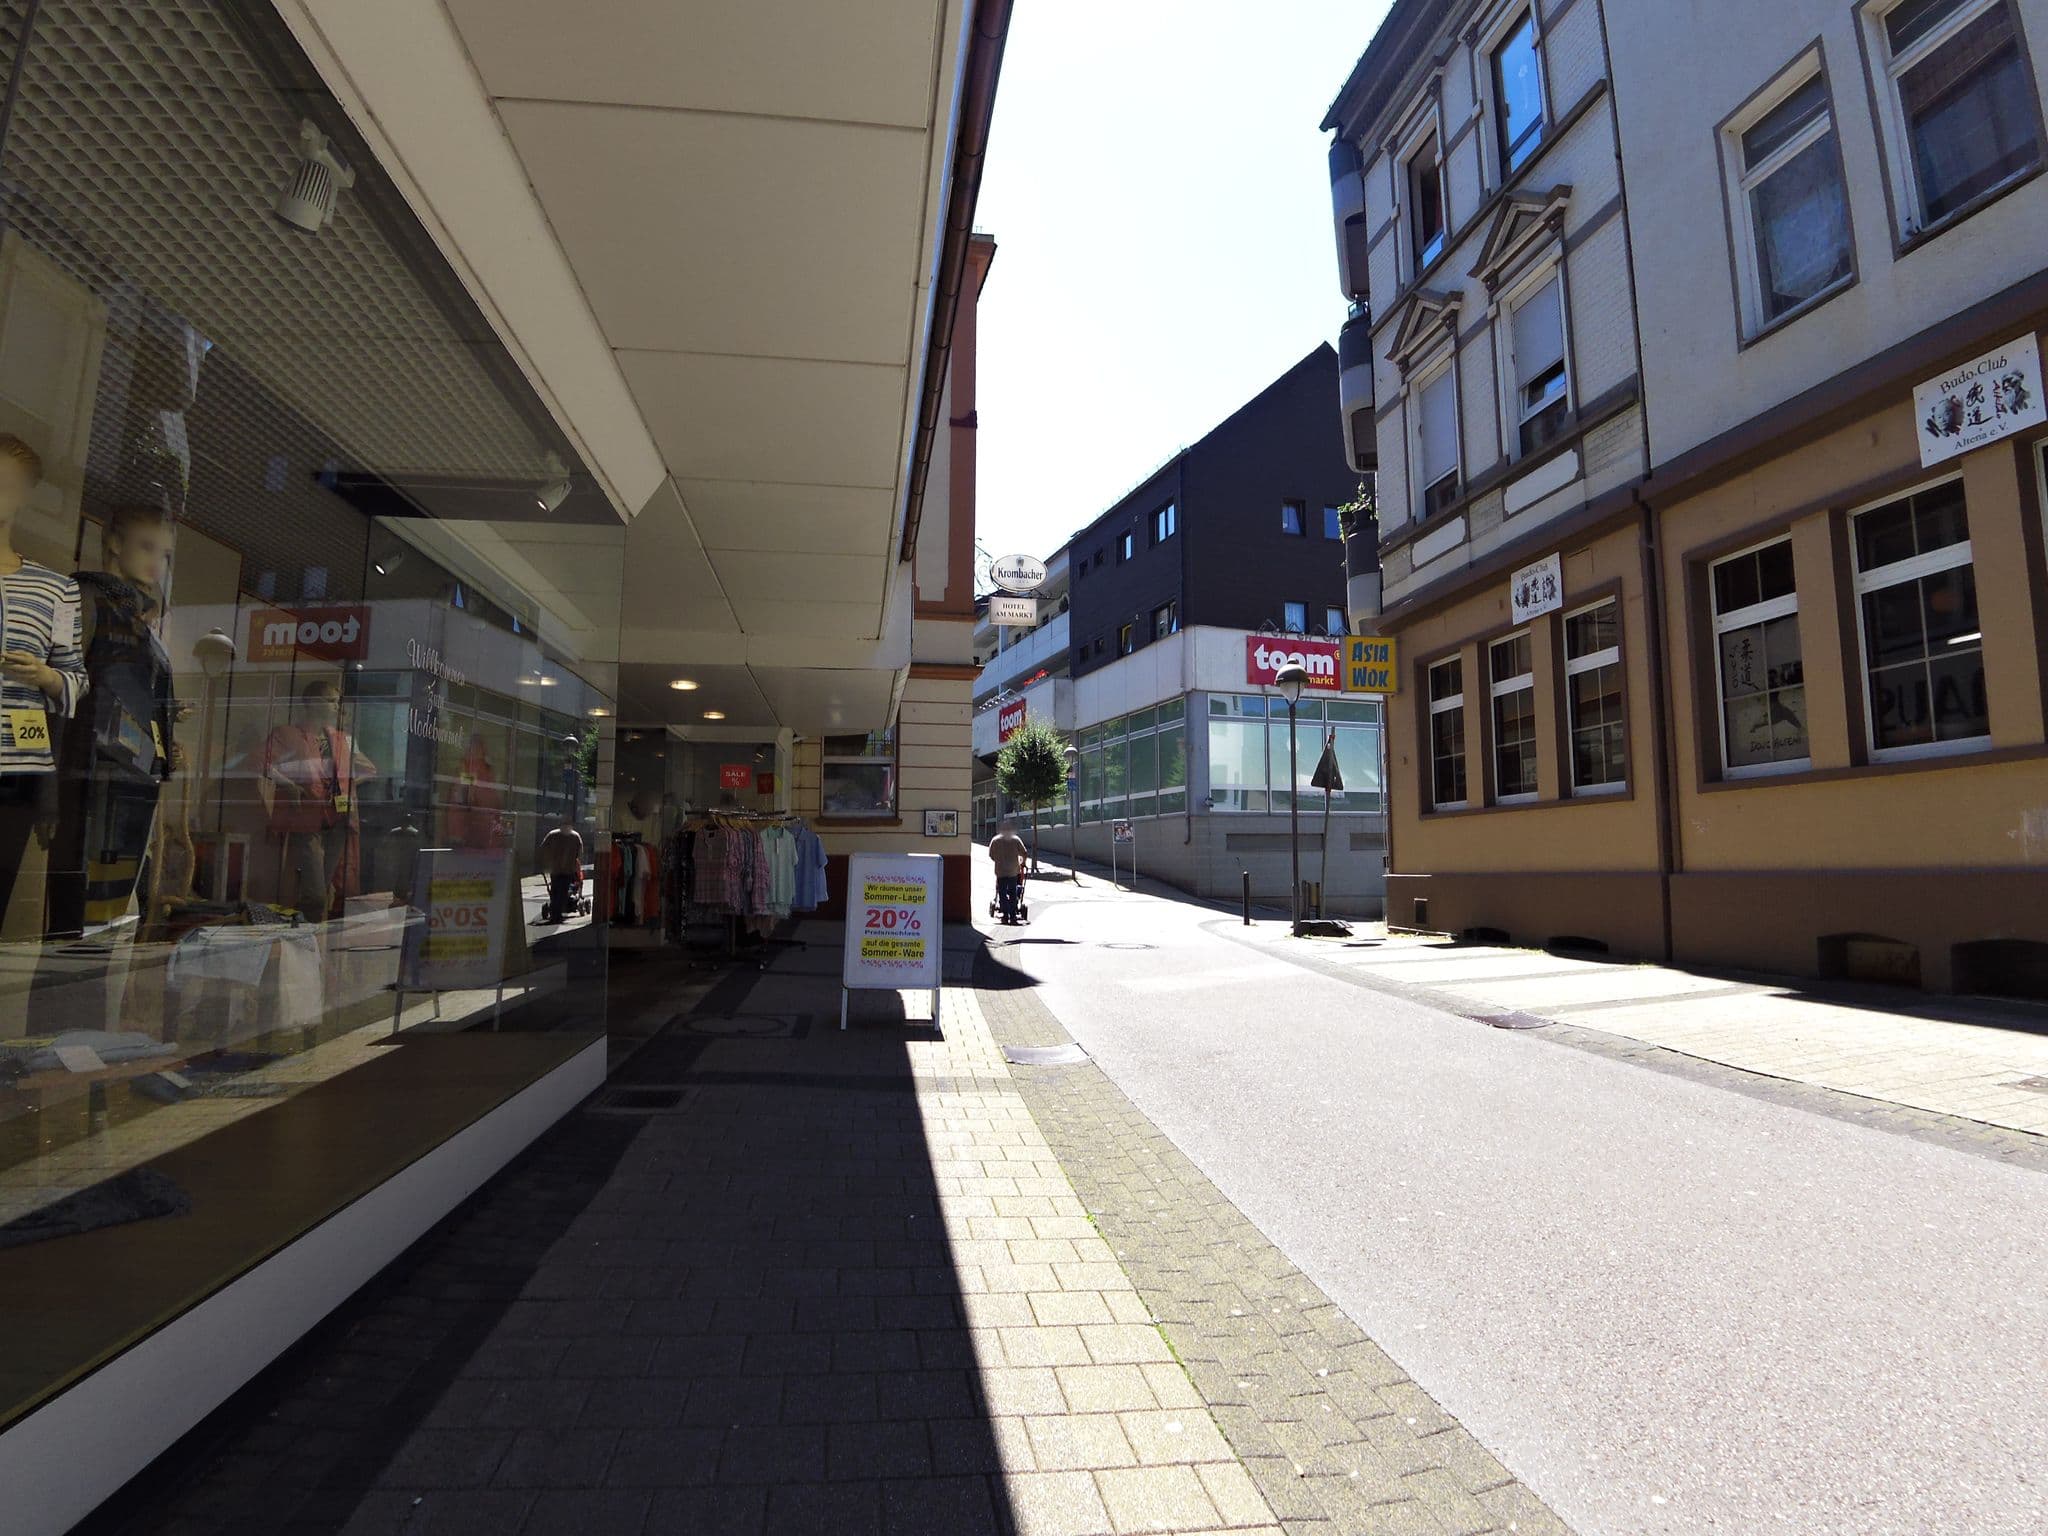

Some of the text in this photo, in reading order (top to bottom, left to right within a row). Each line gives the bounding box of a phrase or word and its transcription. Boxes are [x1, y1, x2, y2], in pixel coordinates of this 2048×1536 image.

[1955, 431, 1987, 450] Altena
[998, 568, 1043, 580] Krombacher
[1001, 709, 1021, 732] toom
[20, 726, 45, 739] 20%
[864, 892, 897, 901] Sommer
[903, 894, 926, 903] Lager
[865, 909, 921, 930] 20%
[862, 948, 898, 957] Sommer
[903, 949, 925, 958] Ware
